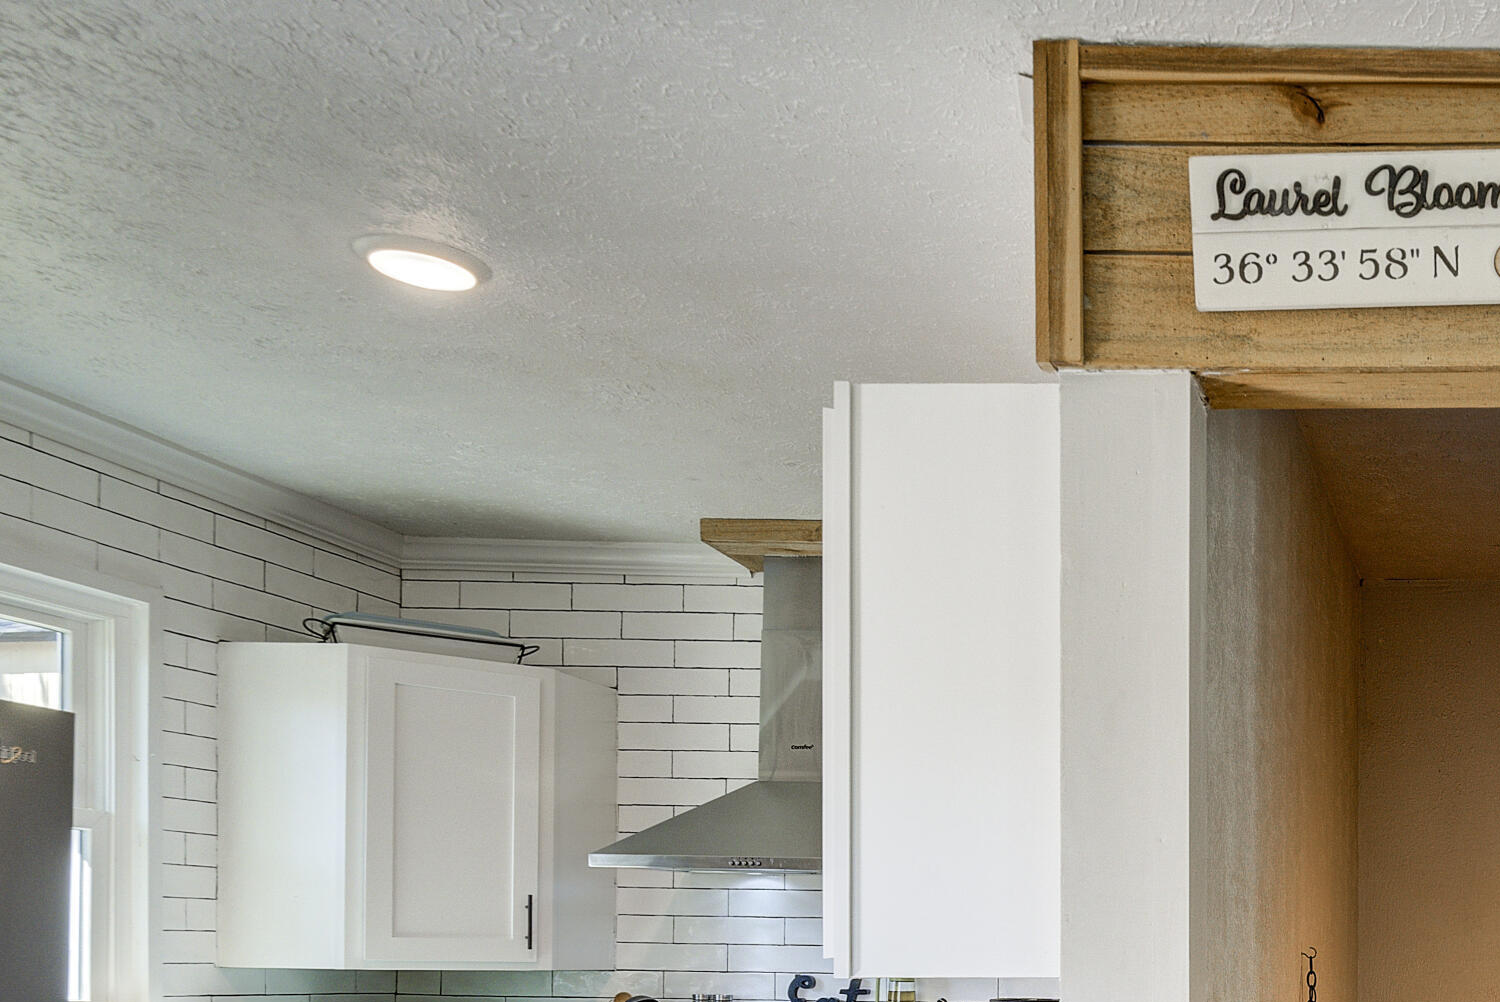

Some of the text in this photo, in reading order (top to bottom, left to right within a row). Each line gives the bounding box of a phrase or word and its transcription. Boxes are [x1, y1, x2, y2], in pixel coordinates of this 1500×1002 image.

[1210, 168, 1349, 221] Laurel
[1292, 249, 1346, 283] 33'
[1359, 247, 1420, 281] 58"
[1433, 245, 1460, 278] N
